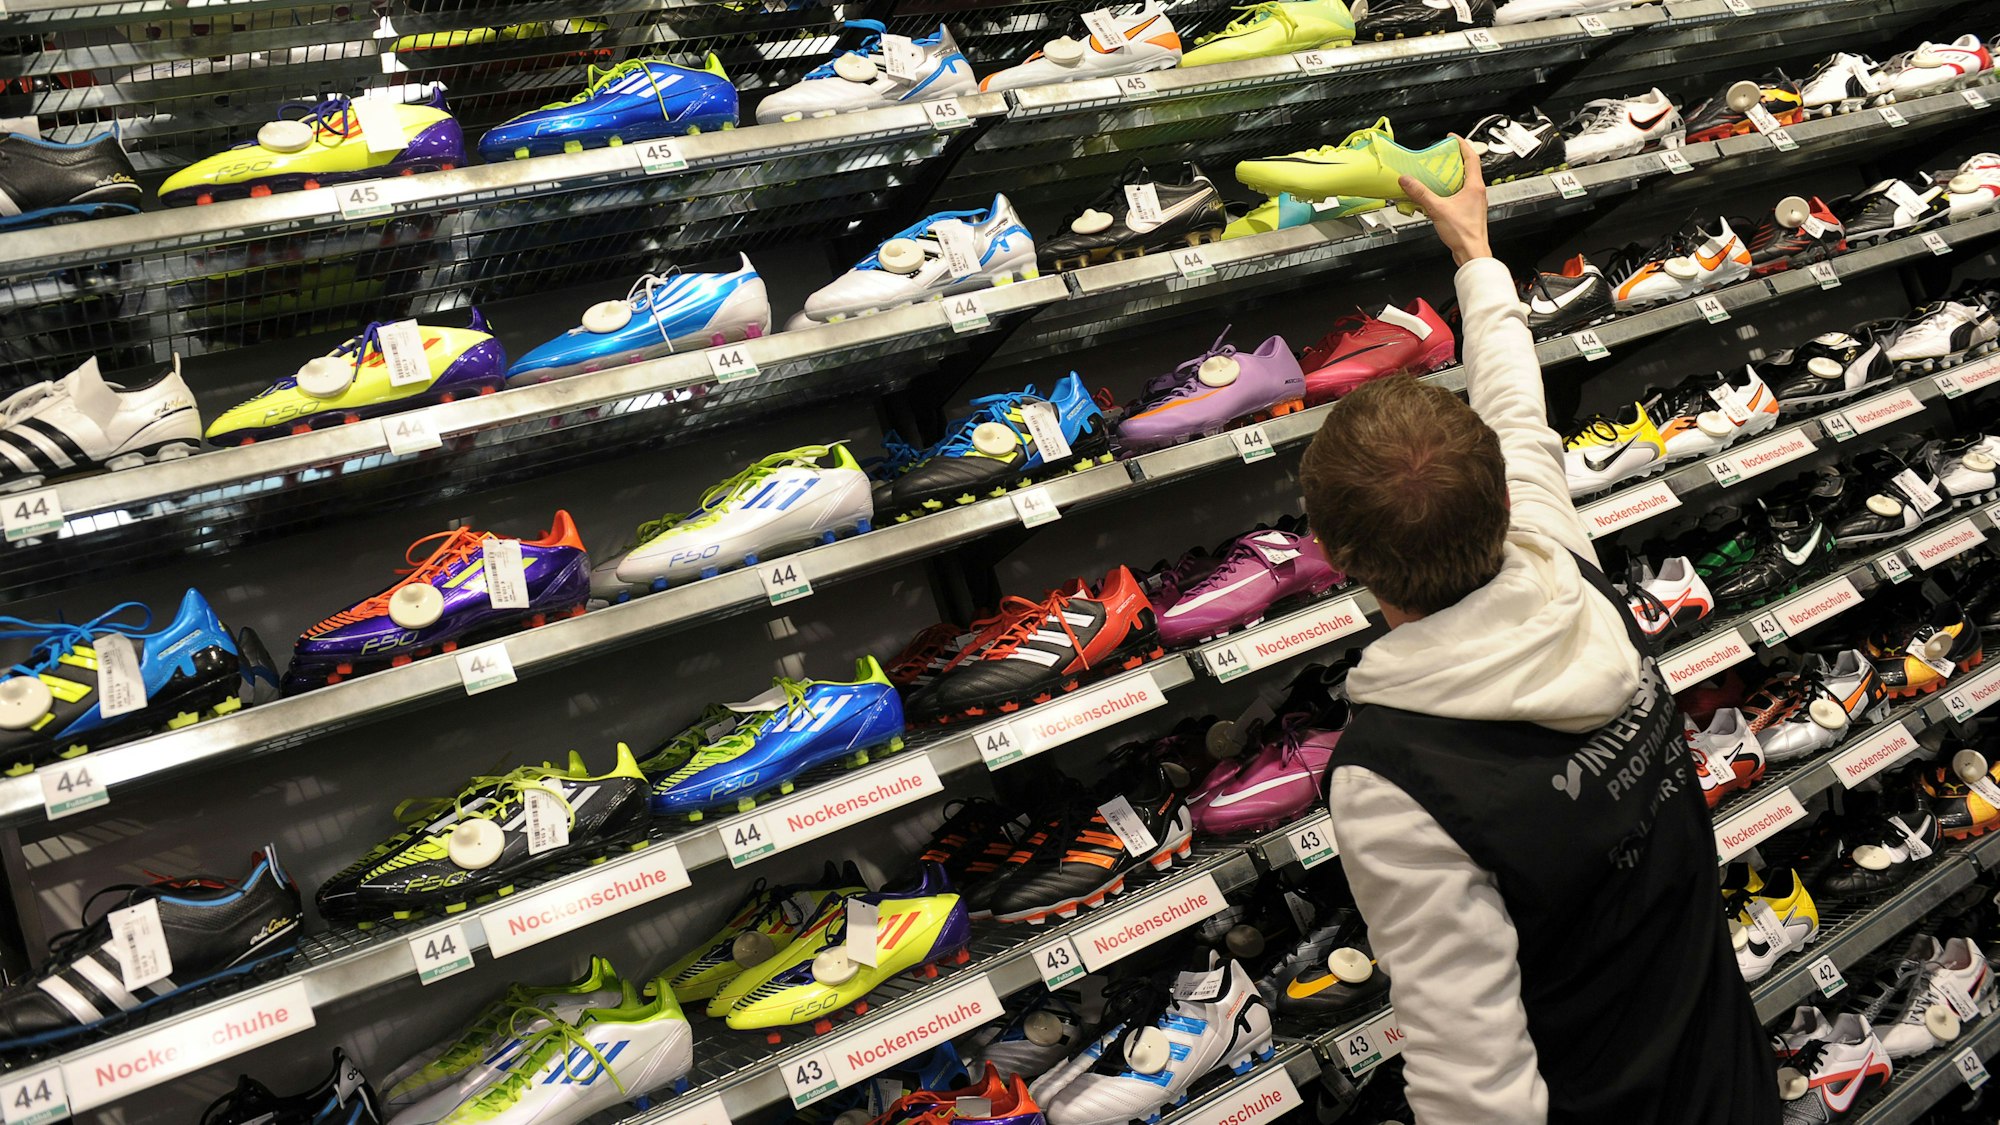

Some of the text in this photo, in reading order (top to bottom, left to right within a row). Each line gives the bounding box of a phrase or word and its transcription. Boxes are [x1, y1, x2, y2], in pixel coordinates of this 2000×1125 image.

[1586, 17, 1601, 28] 45
[1474, 33, 1489, 43] 45
[1305, 53, 1323, 66] 45
[1126, 77, 1146, 89] 45
[935, 101, 957, 118] 45
[535, 116, 586, 137] F50
[1776, 132, 1789, 141] 44
[646, 143, 673, 161] 45
[1667, 154, 1682, 165] 44
[214, 160, 270, 182] F50
[1561, 175, 1576, 187] 44
[350, 186, 380, 205] 45
[1929, 236, 1941, 247] 44
[1183, 251, 1204, 267] 44
[1818, 266, 1832, 277] 44
[955, 298, 978, 316] 44
[1704, 300, 1719, 312] 44
[1581, 334, 1597, 346] 44
[718, 350, 744, 369] 44
[1941, 377, 1954, 389] 44
[262, 401, 320, 425] F50
[1856, 397, 1913, 425] Nockenschuhe
[395, 415, 425, 438] 44
[1831, 418, 1844, 430] 44
[1244, 430, 1263, 447] 44
[1740, 439, 1805, 469] Nockenschuhe
[1717, 463, 1731, 475] 44
[15, 497, 50, 520] 44
[1594, 493, 1669, 528] Nockenschuhe
[1919, 529, 1975, 560] Nockenschuhe
[668, 545, 720, 568] F50
[1886, 559, 1901, 572] 43
[772, 564, 797, 586] 44
[1788, 590, 1852, 626] Nockenschuhe
[1255, 613, 1353, 657] Nockenschuhe
[1761, 619, 1775, 634] 43
[361, 630, 420, 655] F50
[470, 654, 498, 674] 44
[1217, 648, 1238, 667] 44
[1669, 643, 1742, 684] Nockenschuhe
[1951, 696, 1965, 710] 43
[1032, 688, 1148, 741] Nockenschuhe
[986, 731, 1010, 752] 44
[1845, 735, 1908, 778] Nockenschuhe
[57, 767, 93, 793] 44
[710, 771, 759, 801] F50
[786, 773, 923, 832] Nockenschuhe
[734, 823, 761, 847] 44
[1722, 803, 1793, 850] Nockenschuhe
[1300, 831, 1321, 852] 43
[744, 847, 766, 861] Fußball
[404, 871, 467, 894] F50
[507, 866, 667, 936] Nockenschuhe
[1093, 892, 1209, 956] Nockenschuhe
[424, 933, 456, 961] 44
[432, 960, 460, 976] Fußball
[1046, 946, 1070, 970] 43
[1056, 968, 1075, 983] Fußball
[1819, 964, 1836, 981] 42
[790, 993, 838, 1021] F50
[846, 998, 983, 1071] Nockenschuhe
[1348, 1035, 1369, 1057] 43
[796, 1060, 823, 1085] 43
[1963, 1056, 1979, 1072] 42
[14, 1078, 52, 1110] 44
[806, 1084, 828, 1099] Fußball
